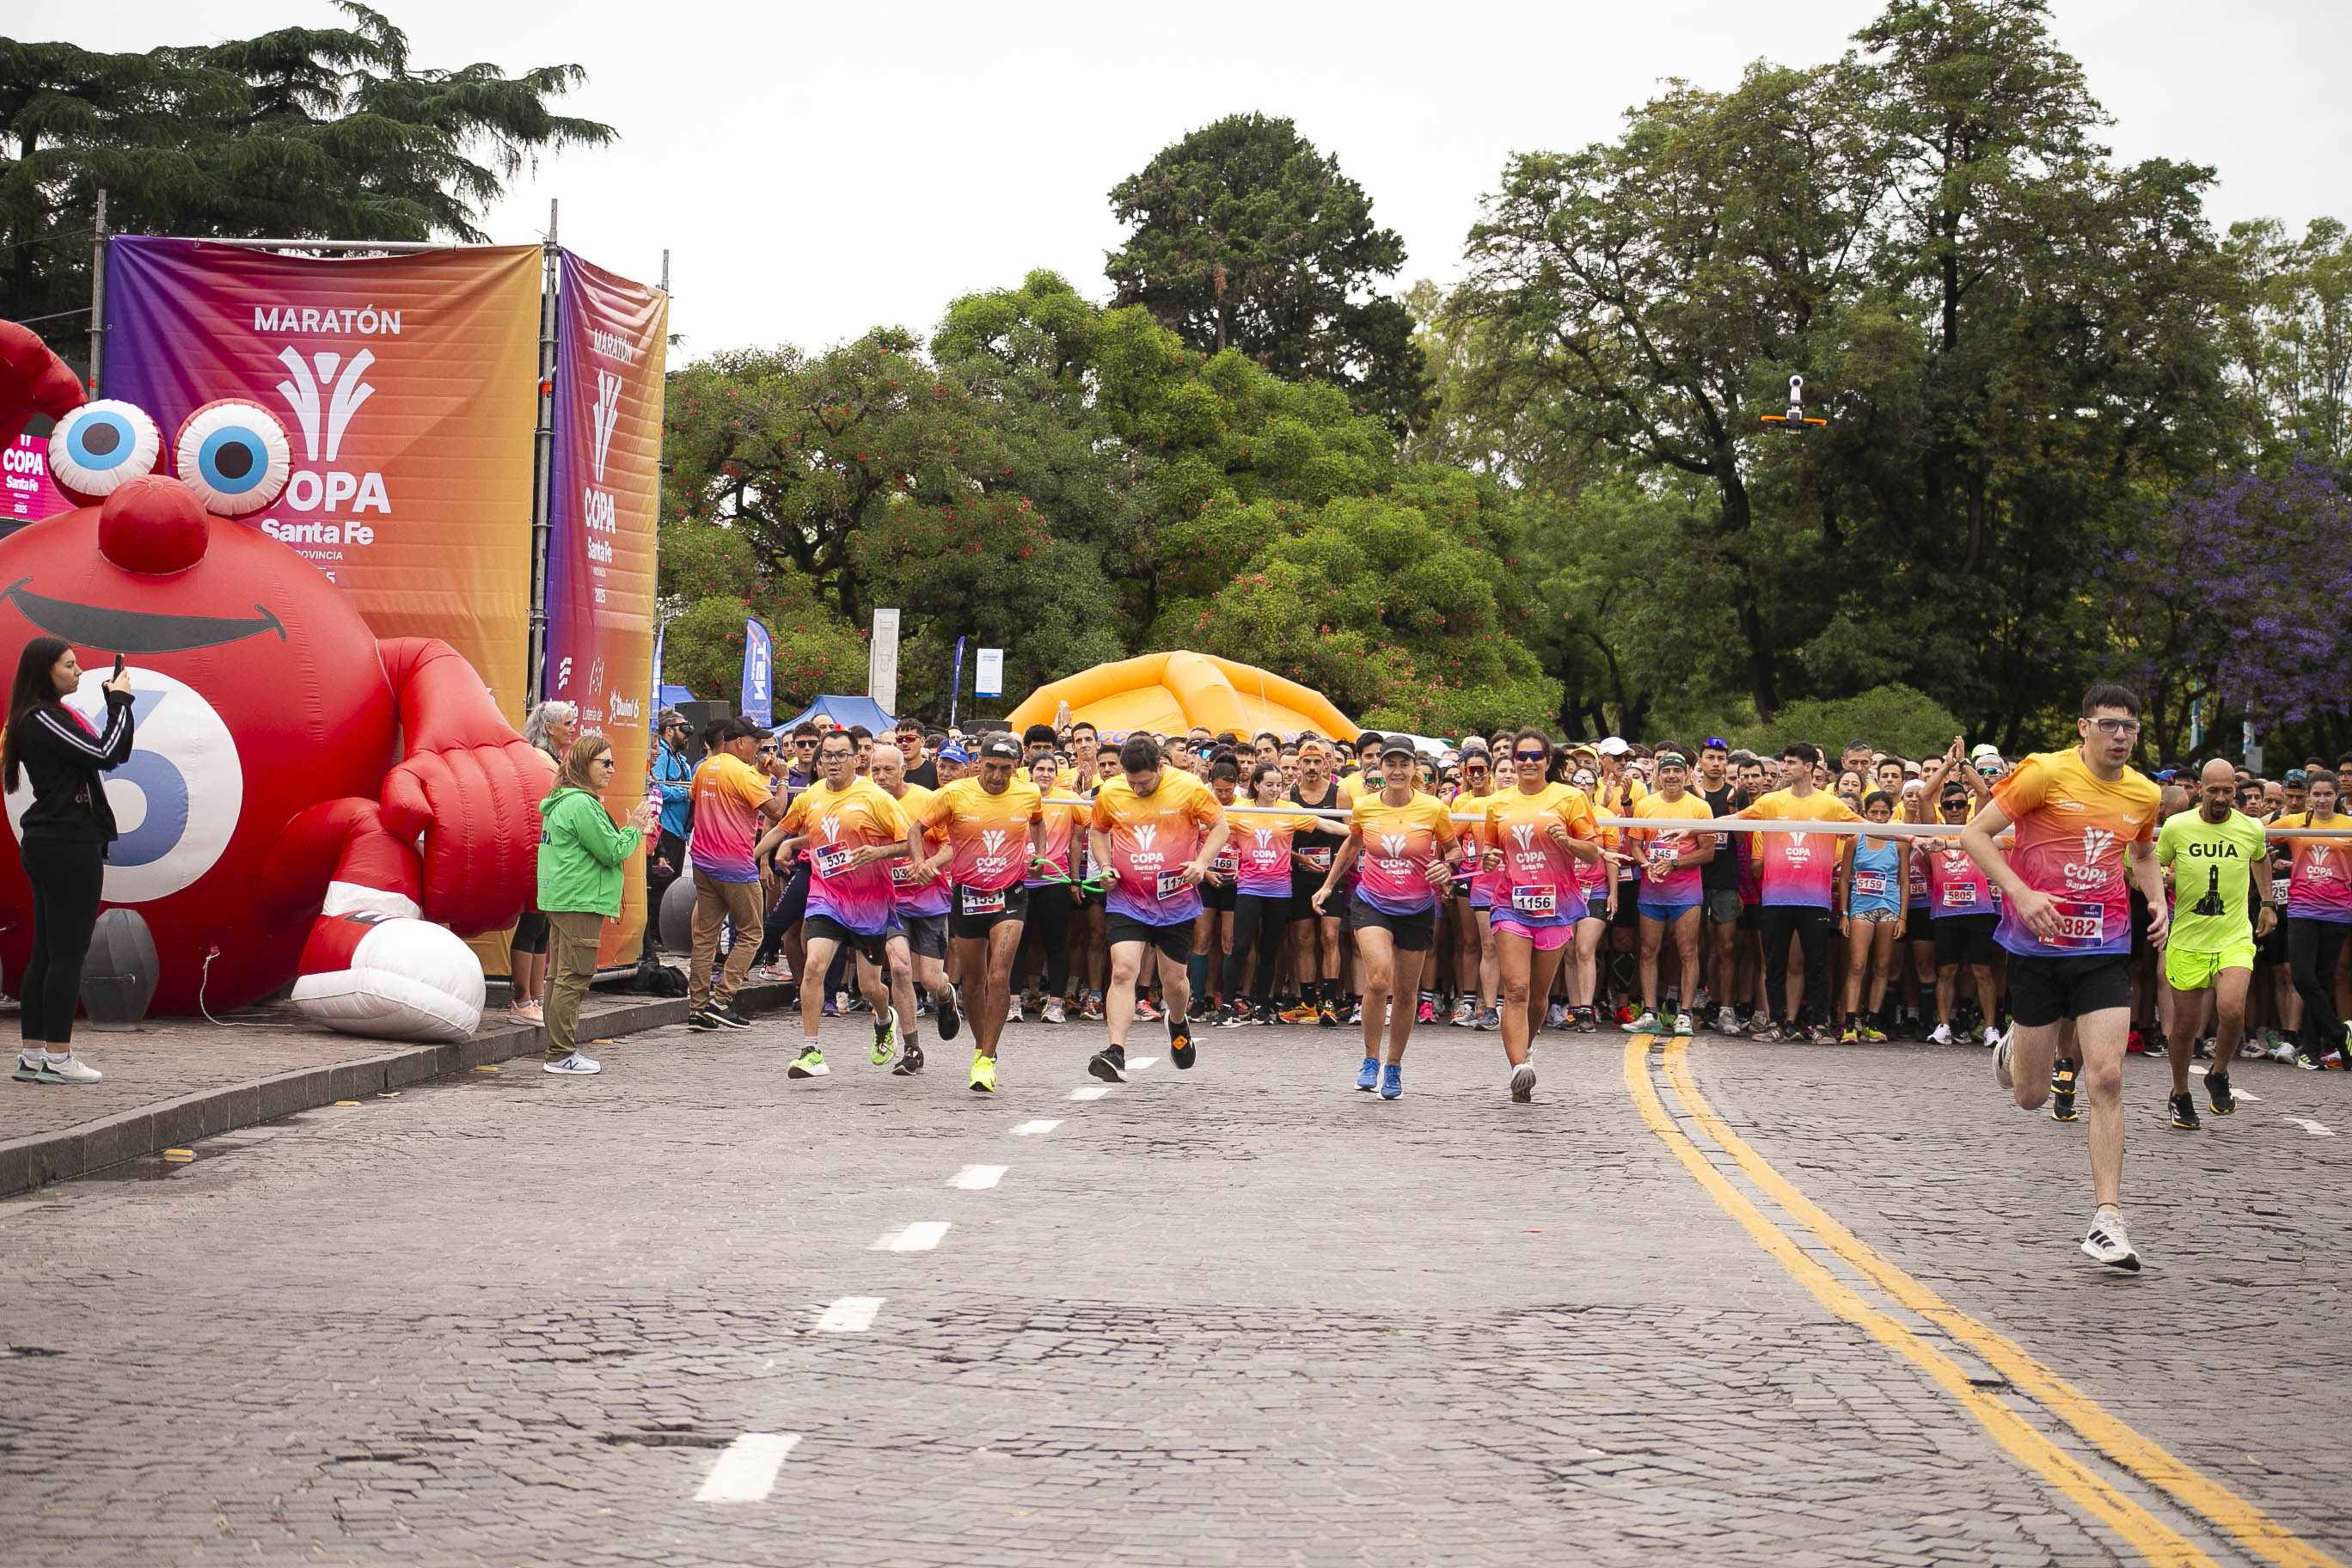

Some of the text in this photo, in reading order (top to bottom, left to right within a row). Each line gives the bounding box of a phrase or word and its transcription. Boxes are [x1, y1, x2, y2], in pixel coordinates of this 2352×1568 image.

[254, 304, 401, 335] MARATÓN
[594, 328, 633, 364] MARATÓN
[3, 448, 44, 475] COPA
[6, 475, 39, 492] Santa Fe
[272, 470, 392, 514] OPA
[585, 487, 616, 534] COPA
[261, 518, 374, 545] Santa Fe
[296, 549, 343, 560] OVINCIA
[587, 536, 612, 563] Santa Fe
[1130, 852, 1165, 864] COPA
[1785, 848, 1810, 856] COPA
[2189, 841, 2239, 858] GUÍA
[827, 852, 847, 867] 532
[1214, 859, 1232, 868] 169
[2064, 862, 2107, 883] COPA
[2306, 866, 2333, 876] COPA
[1858, 879, 1883, 889] 5159
[1519, 897, 1551, 910] 1156
[1948, 891, 1972, 900] 5805
